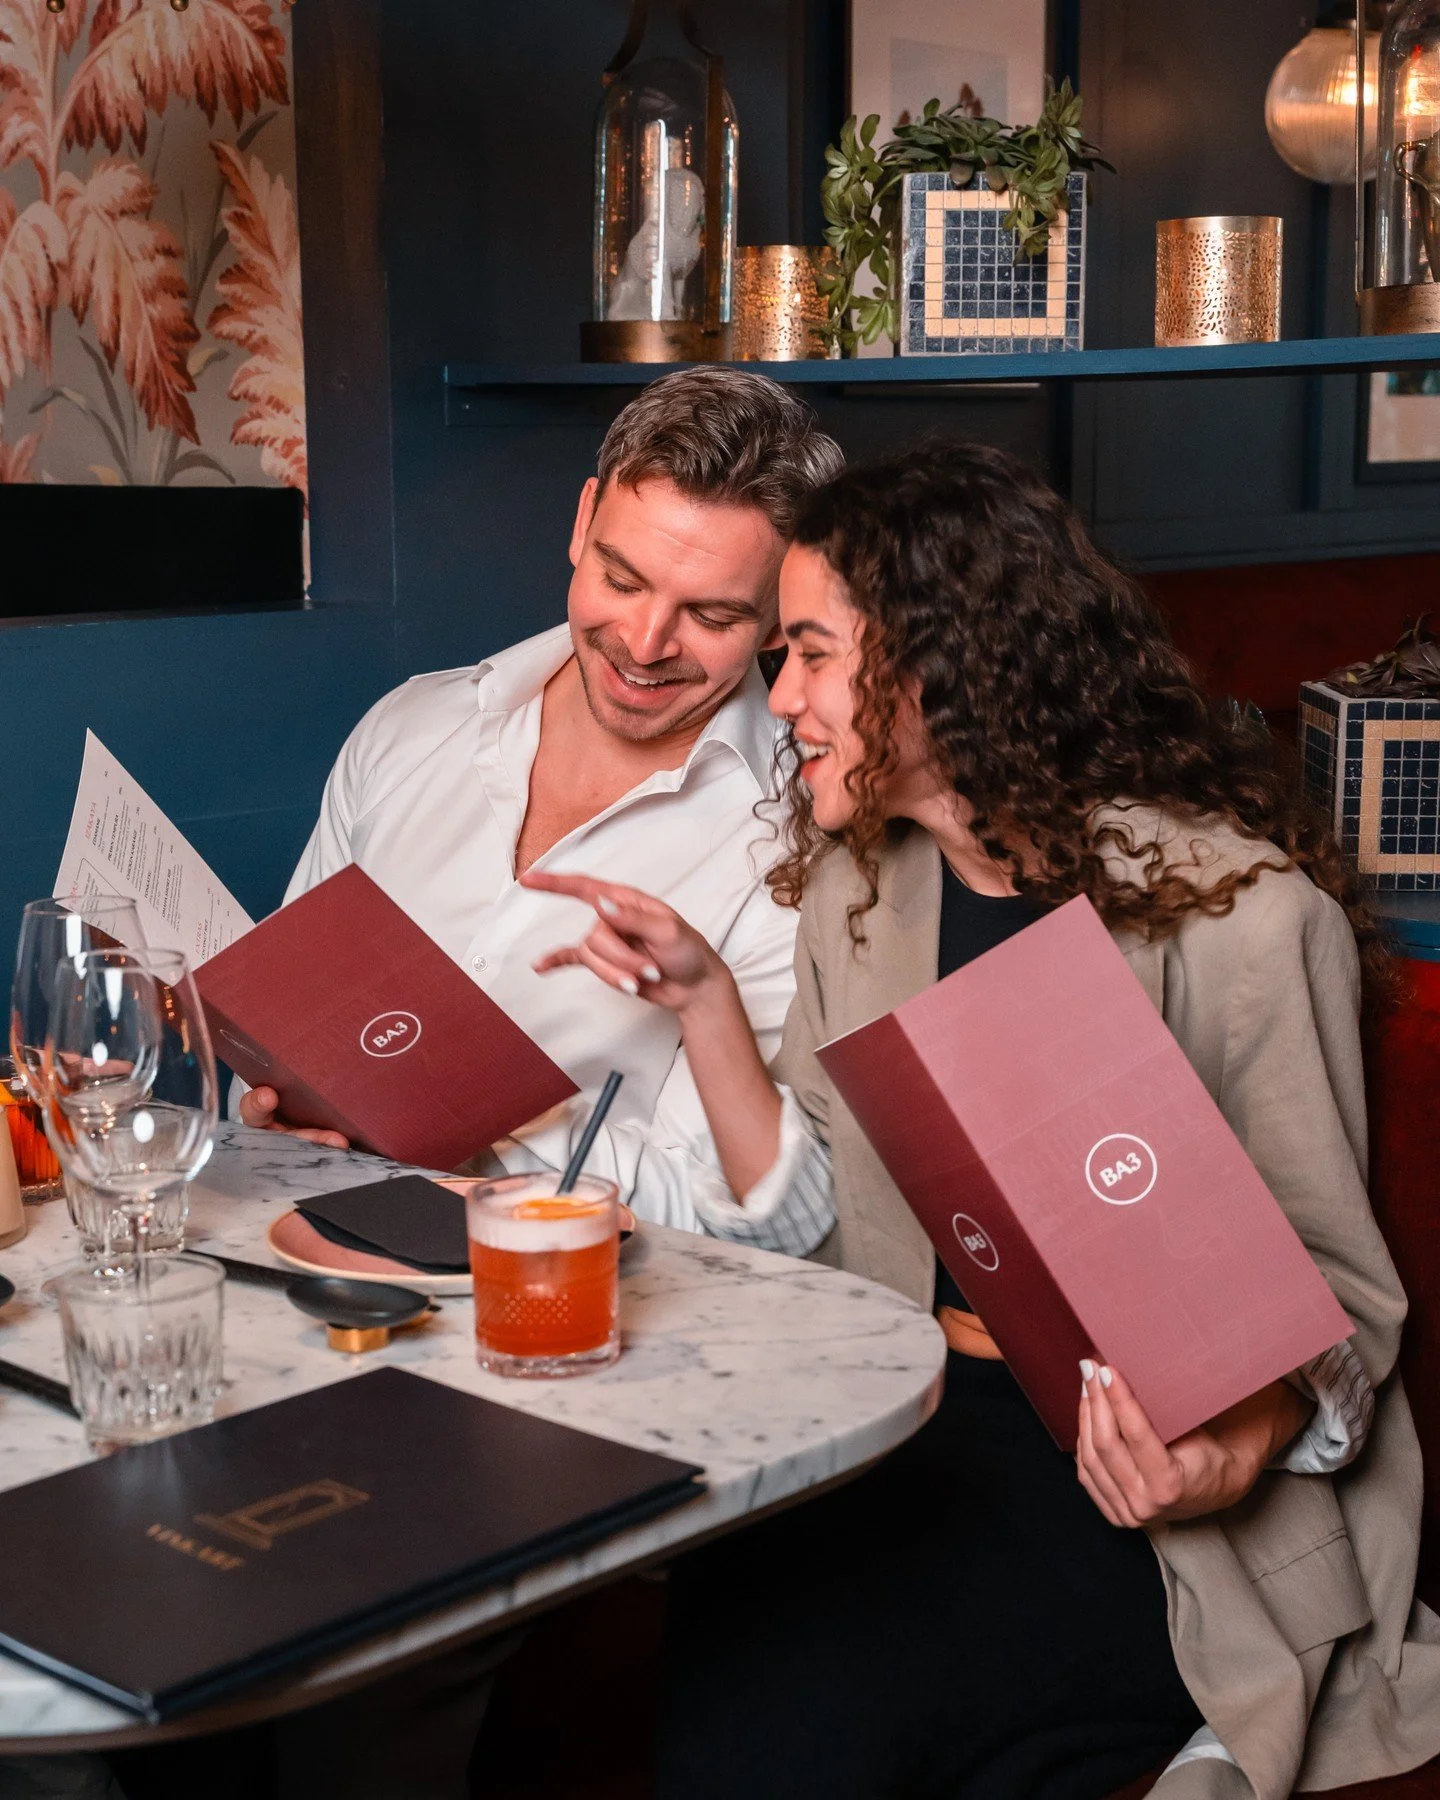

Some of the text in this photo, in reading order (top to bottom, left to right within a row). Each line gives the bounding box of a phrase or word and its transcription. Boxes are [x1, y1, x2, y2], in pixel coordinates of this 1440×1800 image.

[372, 1021, 408, 1048] BA3
[1099, 1152, 1142, 1187] BA3
[964, 1232, 987, 1252] BA3
